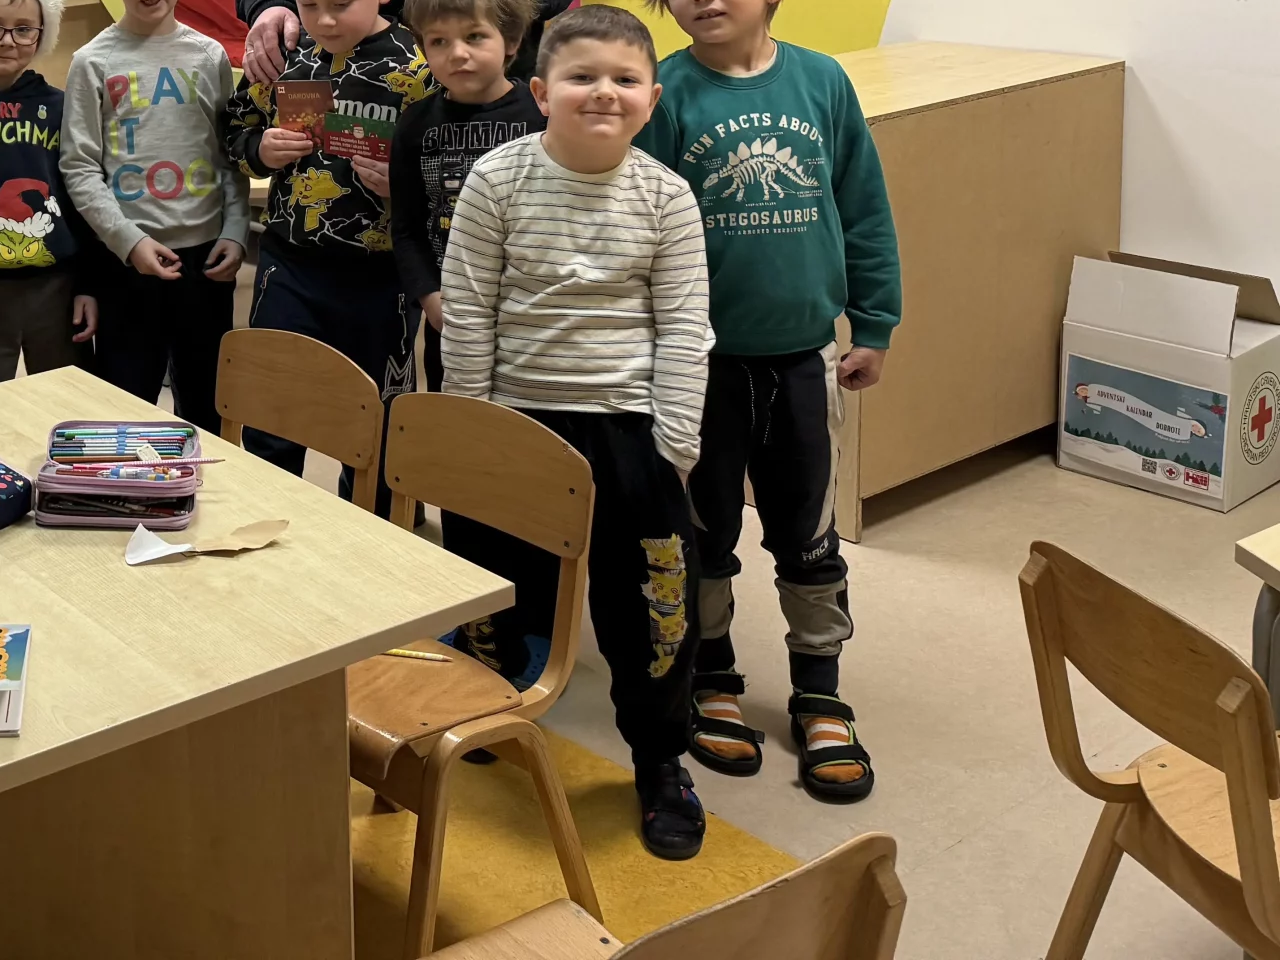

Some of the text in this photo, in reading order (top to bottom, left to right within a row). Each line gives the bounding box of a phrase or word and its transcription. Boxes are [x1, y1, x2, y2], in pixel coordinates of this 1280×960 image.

[105, 66, 200, 110] PLAY
[109, 116, 140, 156] IT
[423, 121, 527, 153] BATMAN
[683, 112, 824, 164] FUN FACTS ABOUT
[705, 207, 819, 229] STEGOSAURUS
[1126, 404, 1153, 419] KALENDAR
[1155, 421, 1181, 436] DOBROTE
